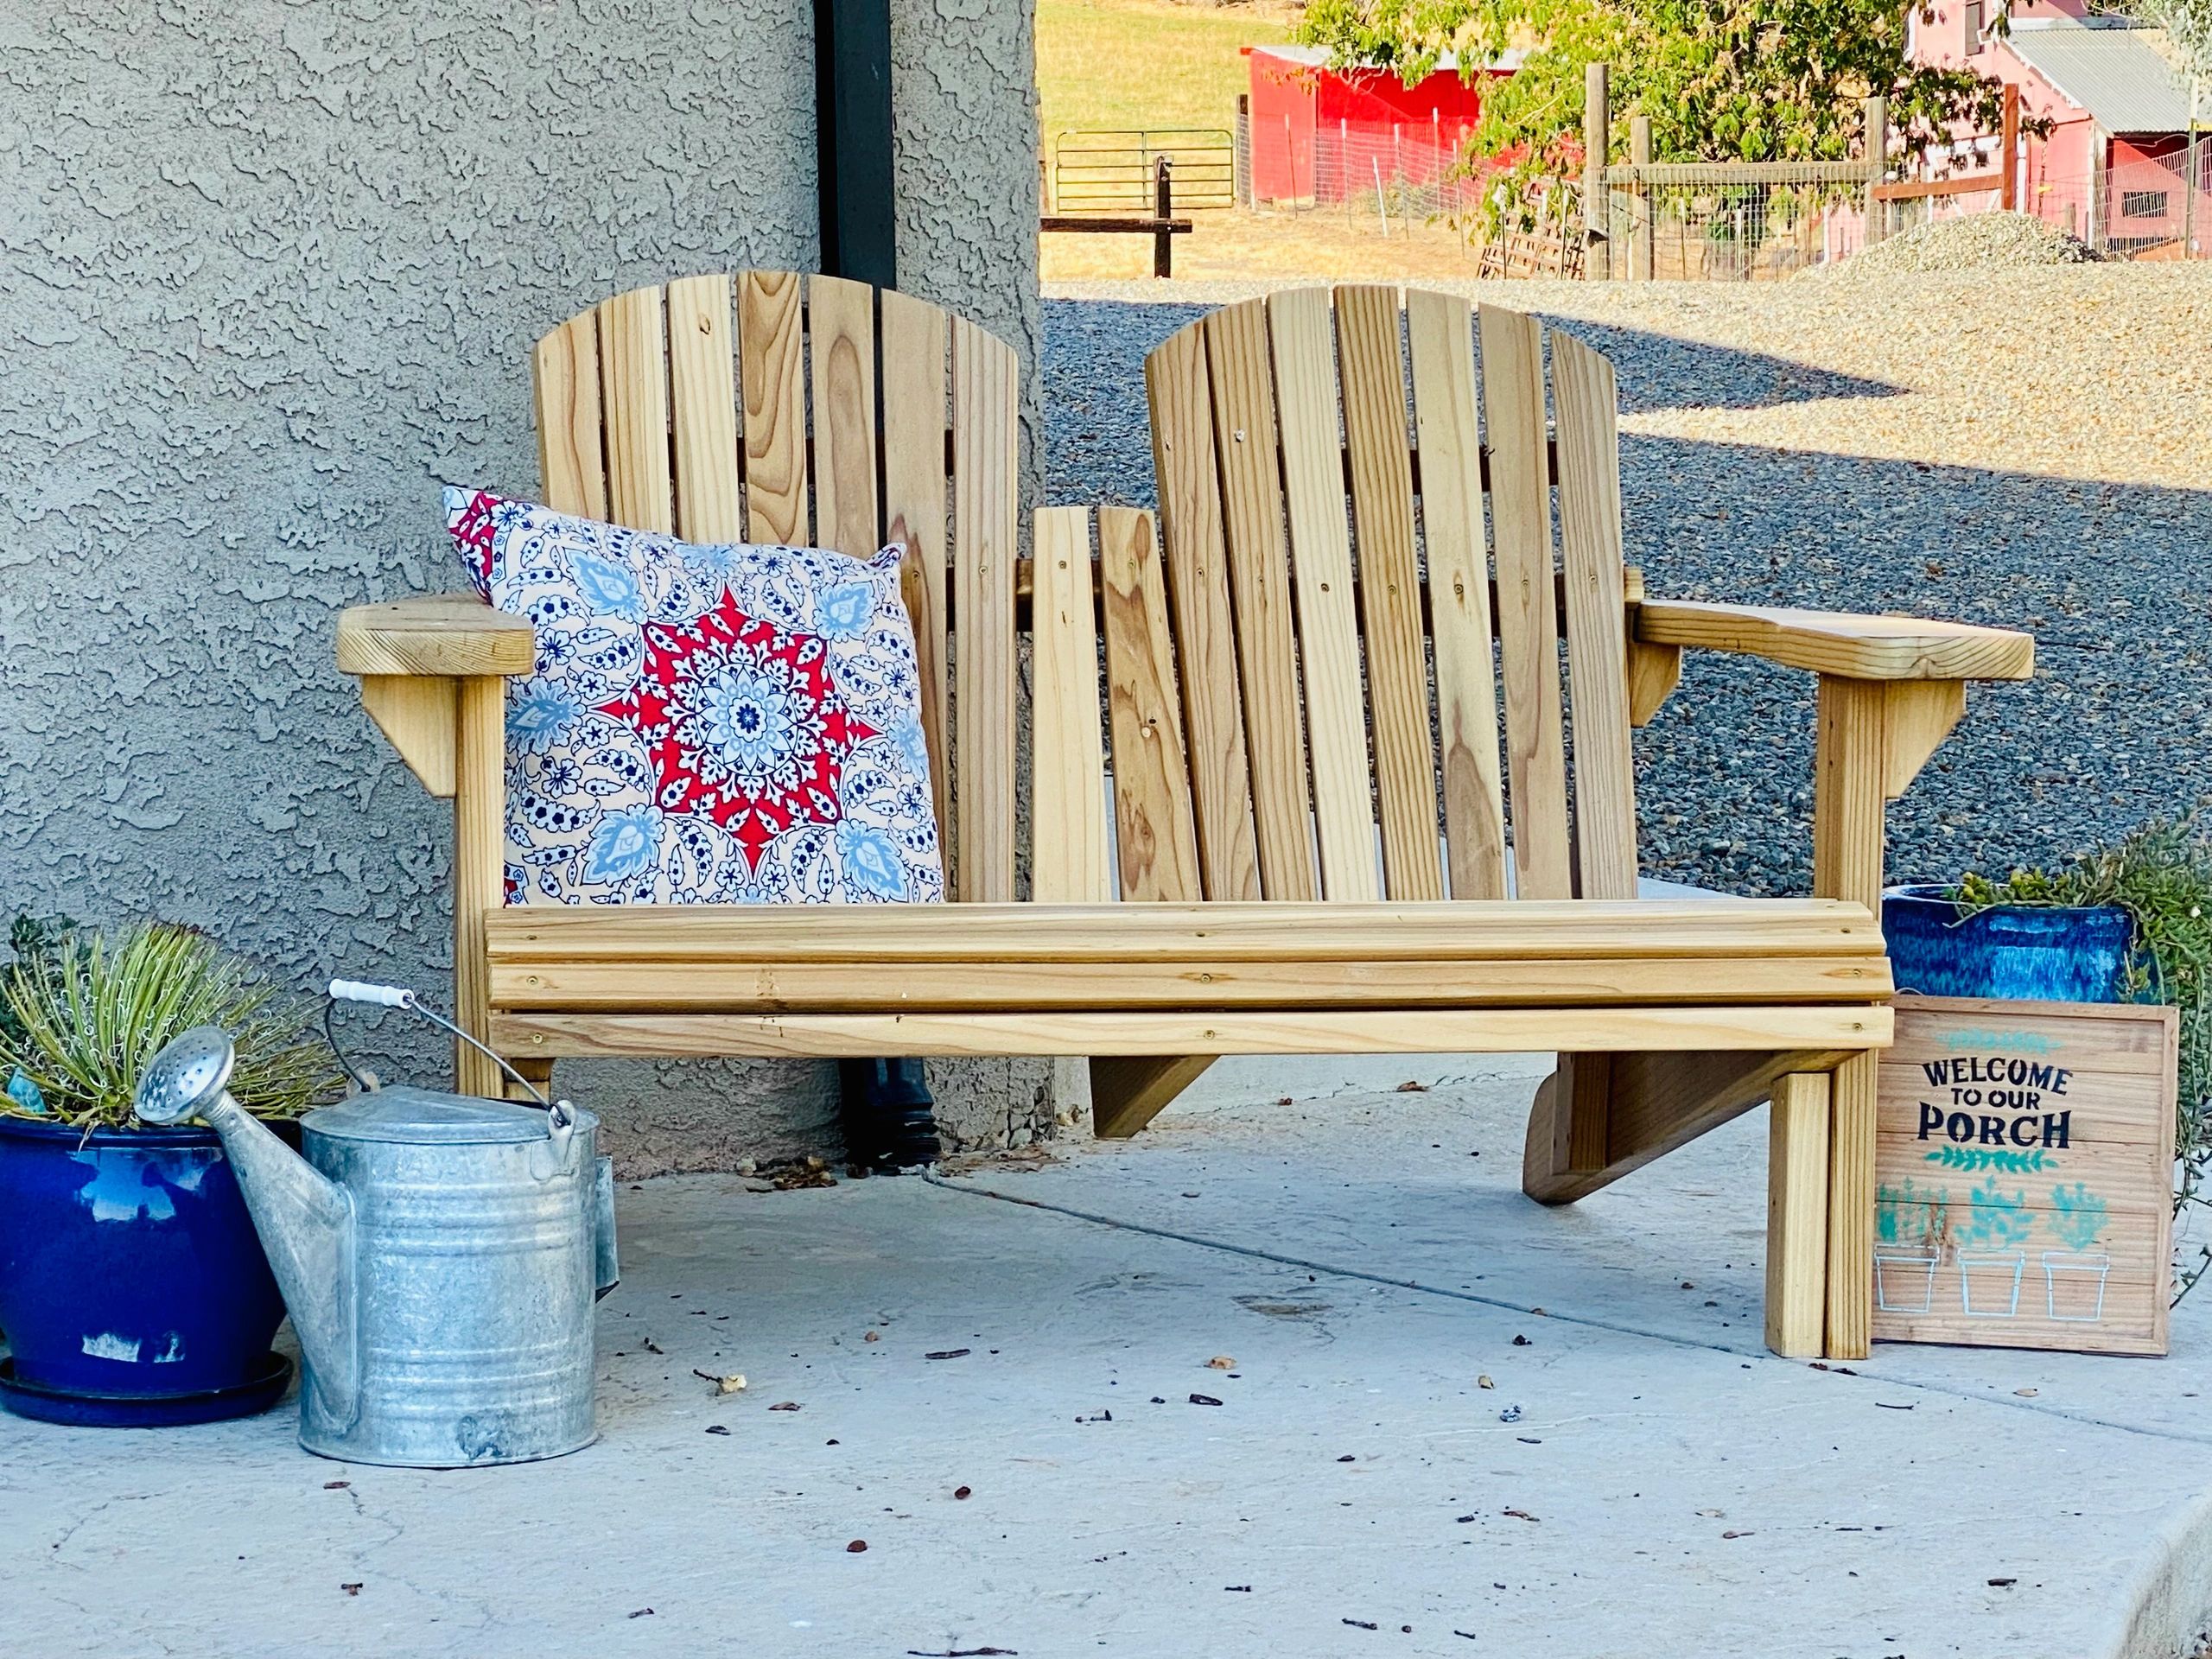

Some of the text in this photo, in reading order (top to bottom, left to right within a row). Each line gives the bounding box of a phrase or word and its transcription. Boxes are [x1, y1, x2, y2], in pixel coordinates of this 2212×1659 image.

[1922, 1057, 2073, 1096] WELCOME
[1951, 1088, 2041, 1109] TO OUR
[1917, 1101, 2071, 1149] PORCH
